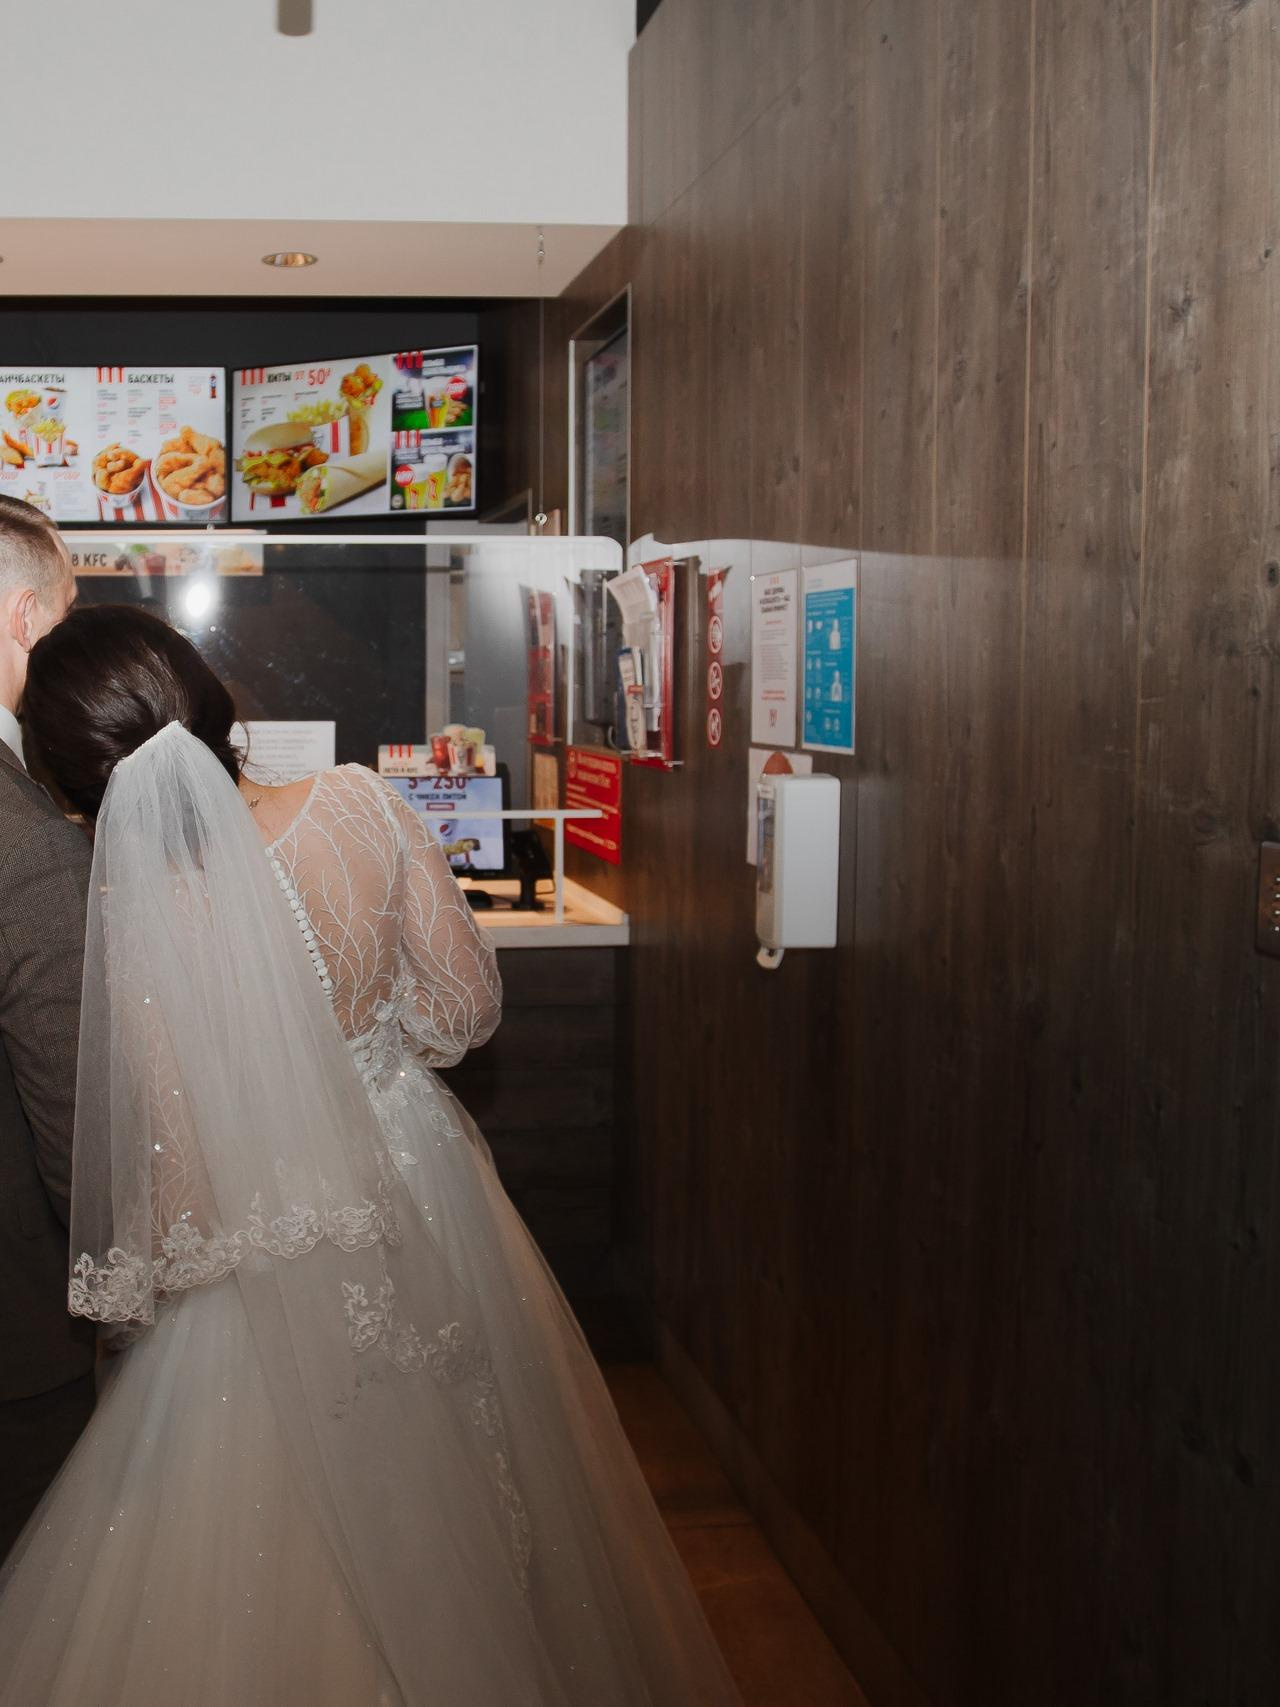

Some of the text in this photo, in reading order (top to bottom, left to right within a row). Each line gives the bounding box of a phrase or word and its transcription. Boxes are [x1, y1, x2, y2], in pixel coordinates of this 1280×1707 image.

[127, 374, 175, 384] БАСКЕТЫ
[71, 553, 108, 567] В KFC
